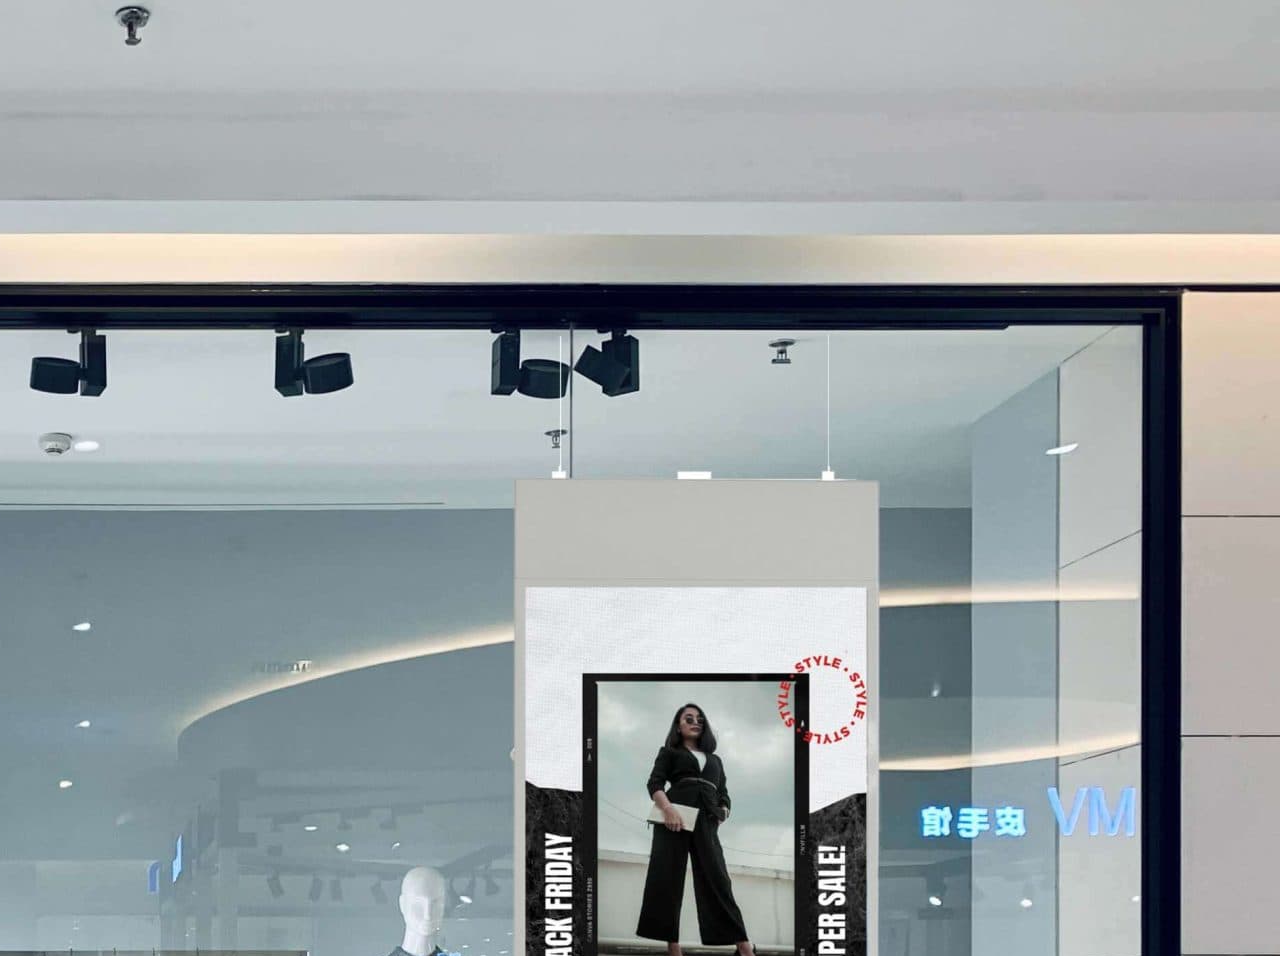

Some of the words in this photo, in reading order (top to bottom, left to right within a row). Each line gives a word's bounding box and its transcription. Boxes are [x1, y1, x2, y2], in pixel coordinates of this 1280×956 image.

[794, 655, 842, 673] STYLE
[777, 681, 796, 728] STYLE
[849, 672, 868, 720] STYLE
[803, 726, 851, 745] STYLE
[544, 832, 573, 911] FRIDAY
[817, 845, 846, 907] SALE!
